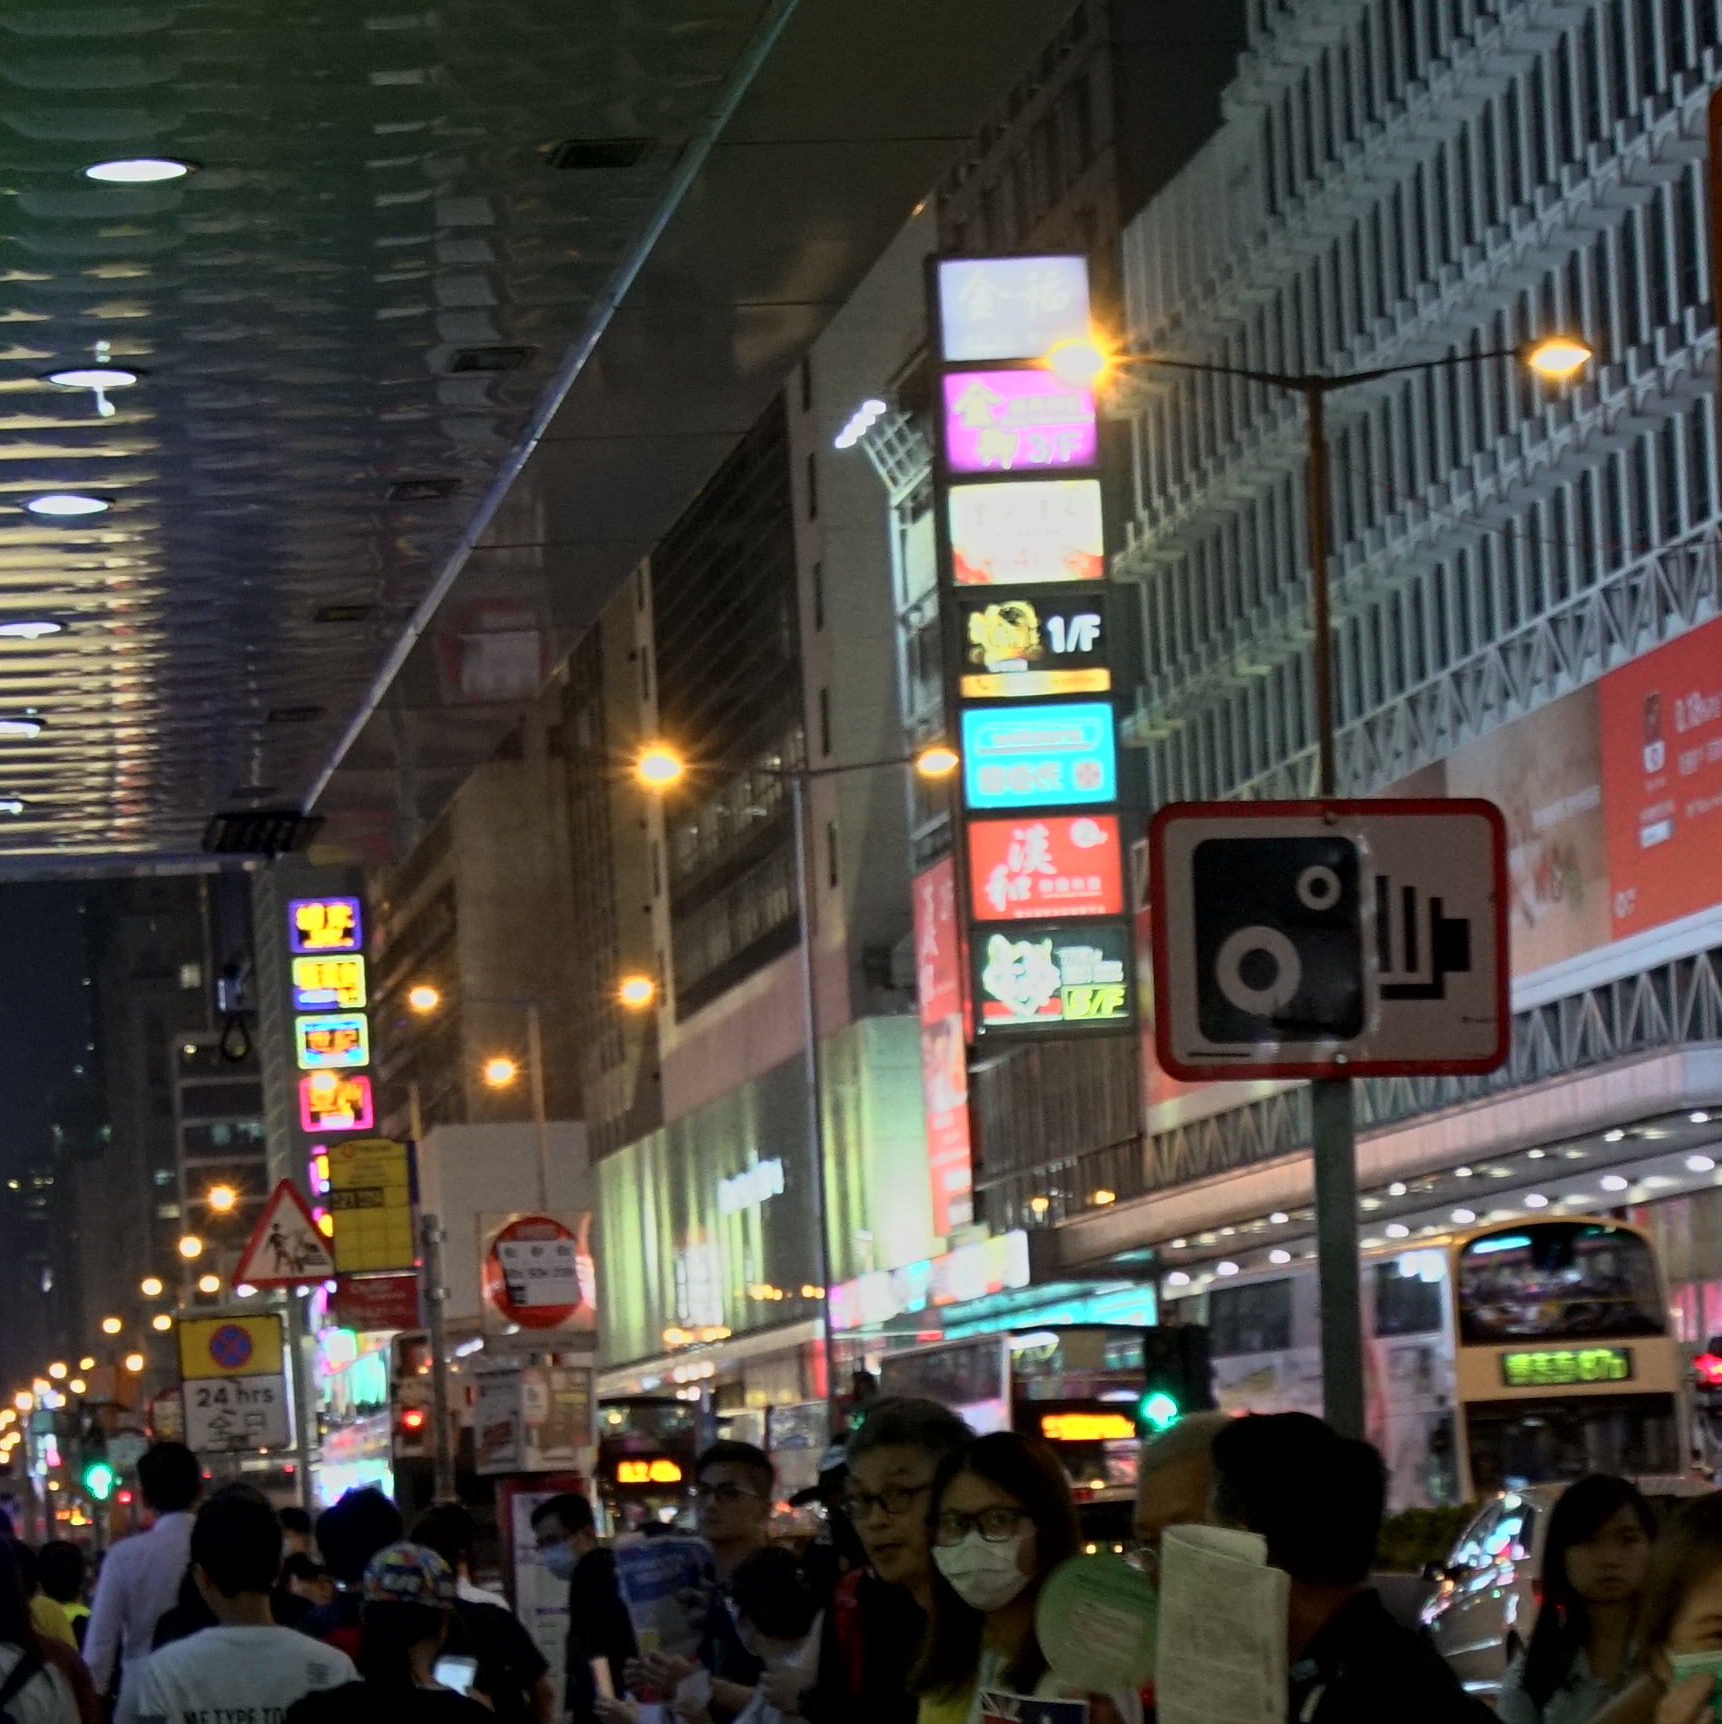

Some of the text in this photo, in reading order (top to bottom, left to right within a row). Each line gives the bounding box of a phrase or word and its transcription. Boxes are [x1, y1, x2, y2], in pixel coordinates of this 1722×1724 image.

[1027, 431, 1082, 465] 3/F
[1047, 613, 1101, 654] 1/F
[196, 1384, 273, 1408] 24 hrs
